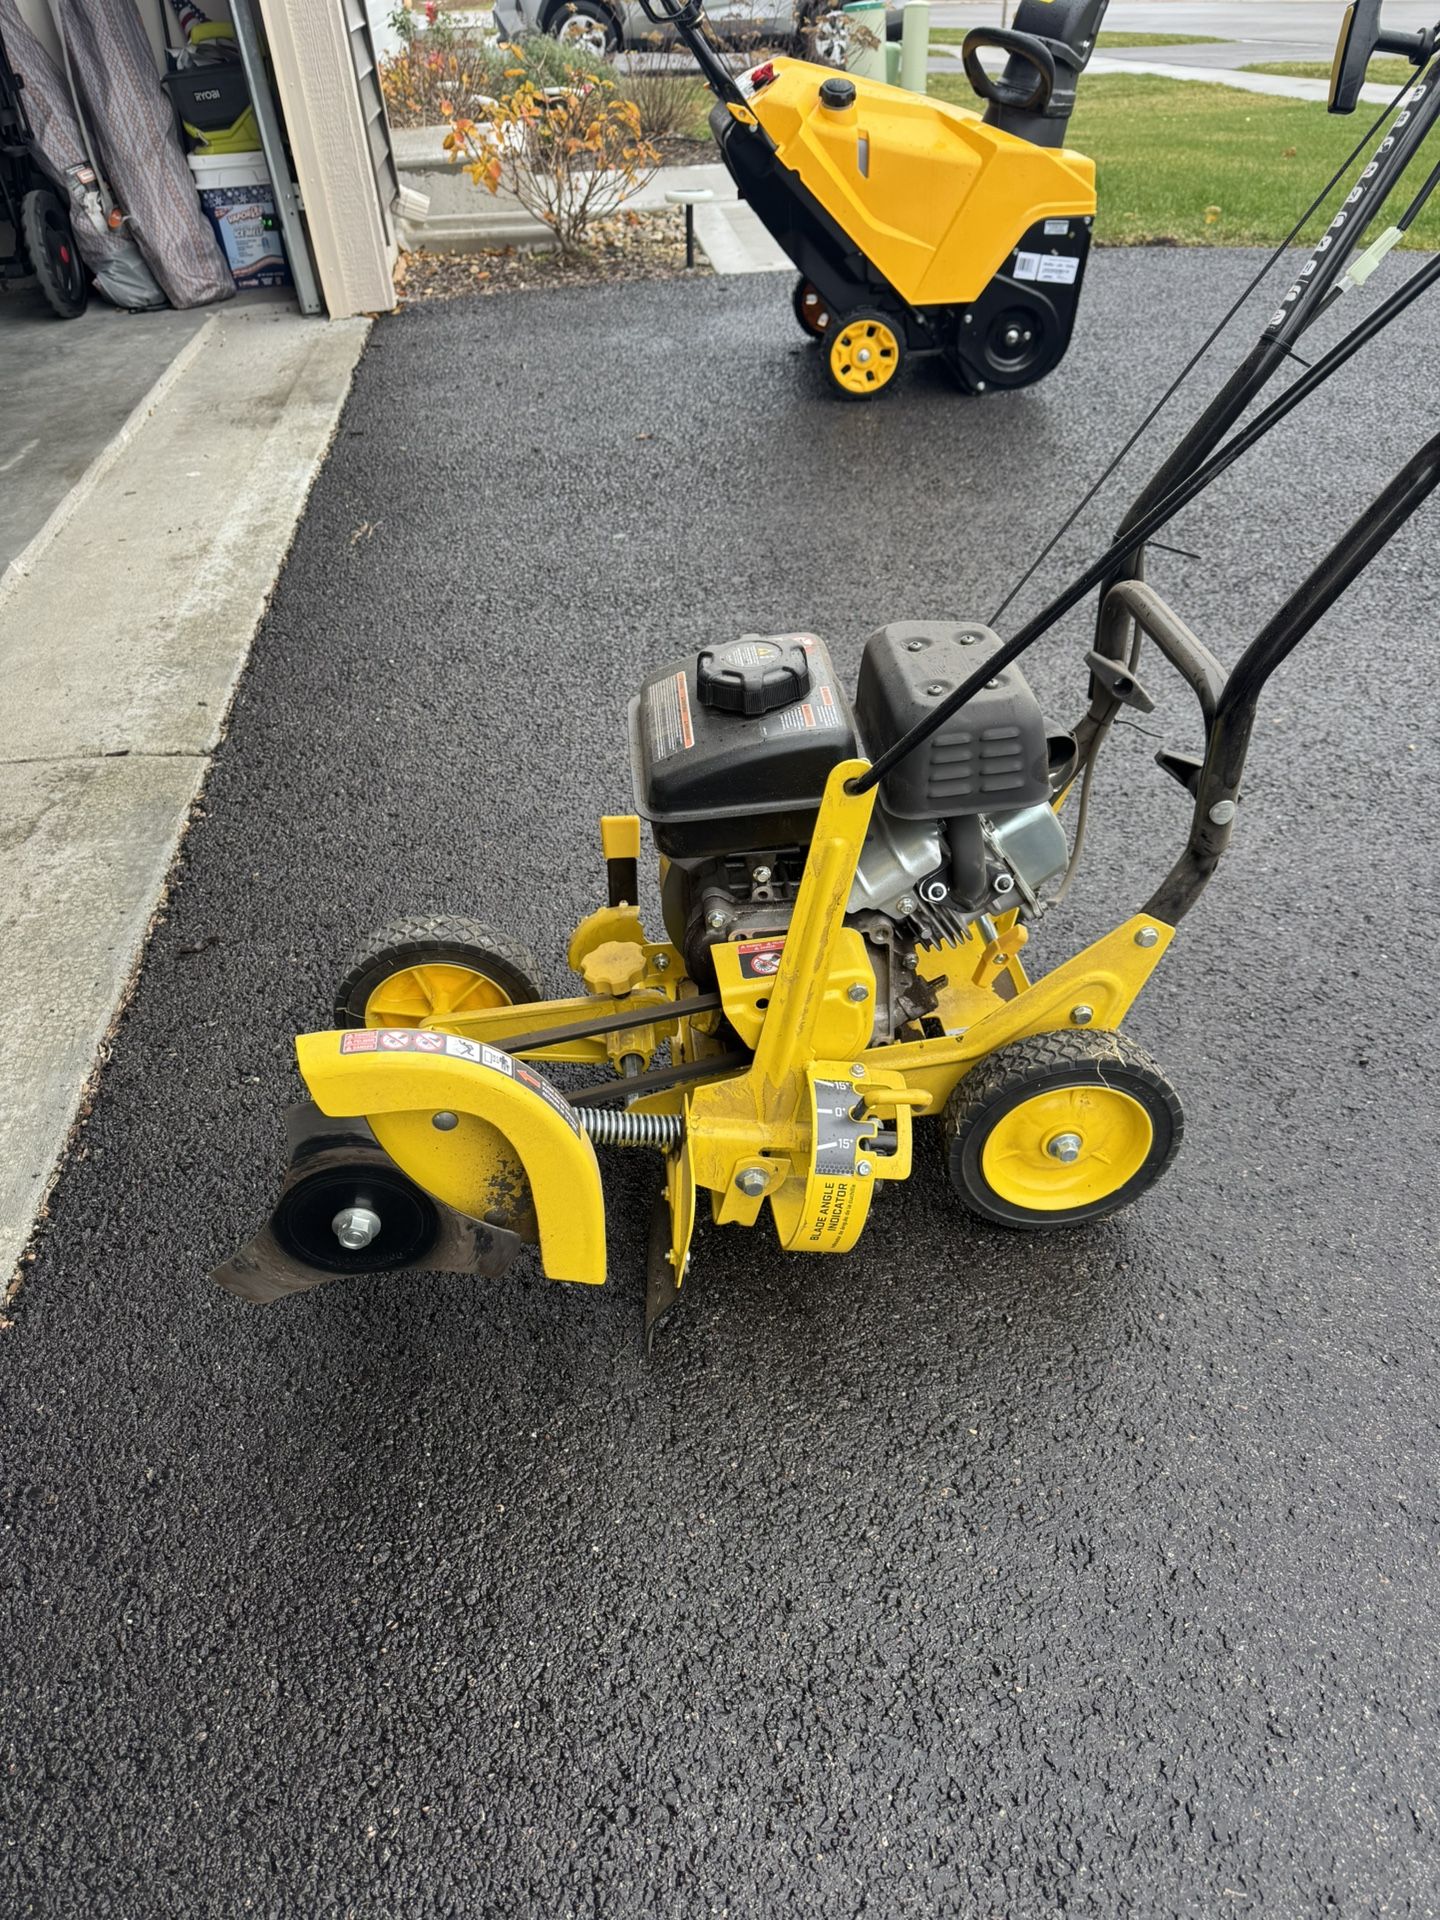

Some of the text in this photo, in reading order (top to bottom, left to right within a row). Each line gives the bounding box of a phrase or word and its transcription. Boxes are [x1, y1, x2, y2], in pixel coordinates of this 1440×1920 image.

[194, 89, 220, 101] RYOBI
[810, 1182, 835, 1241] BLADE ANGLE
[827, 1183, 848, 1232] INDICATOR
